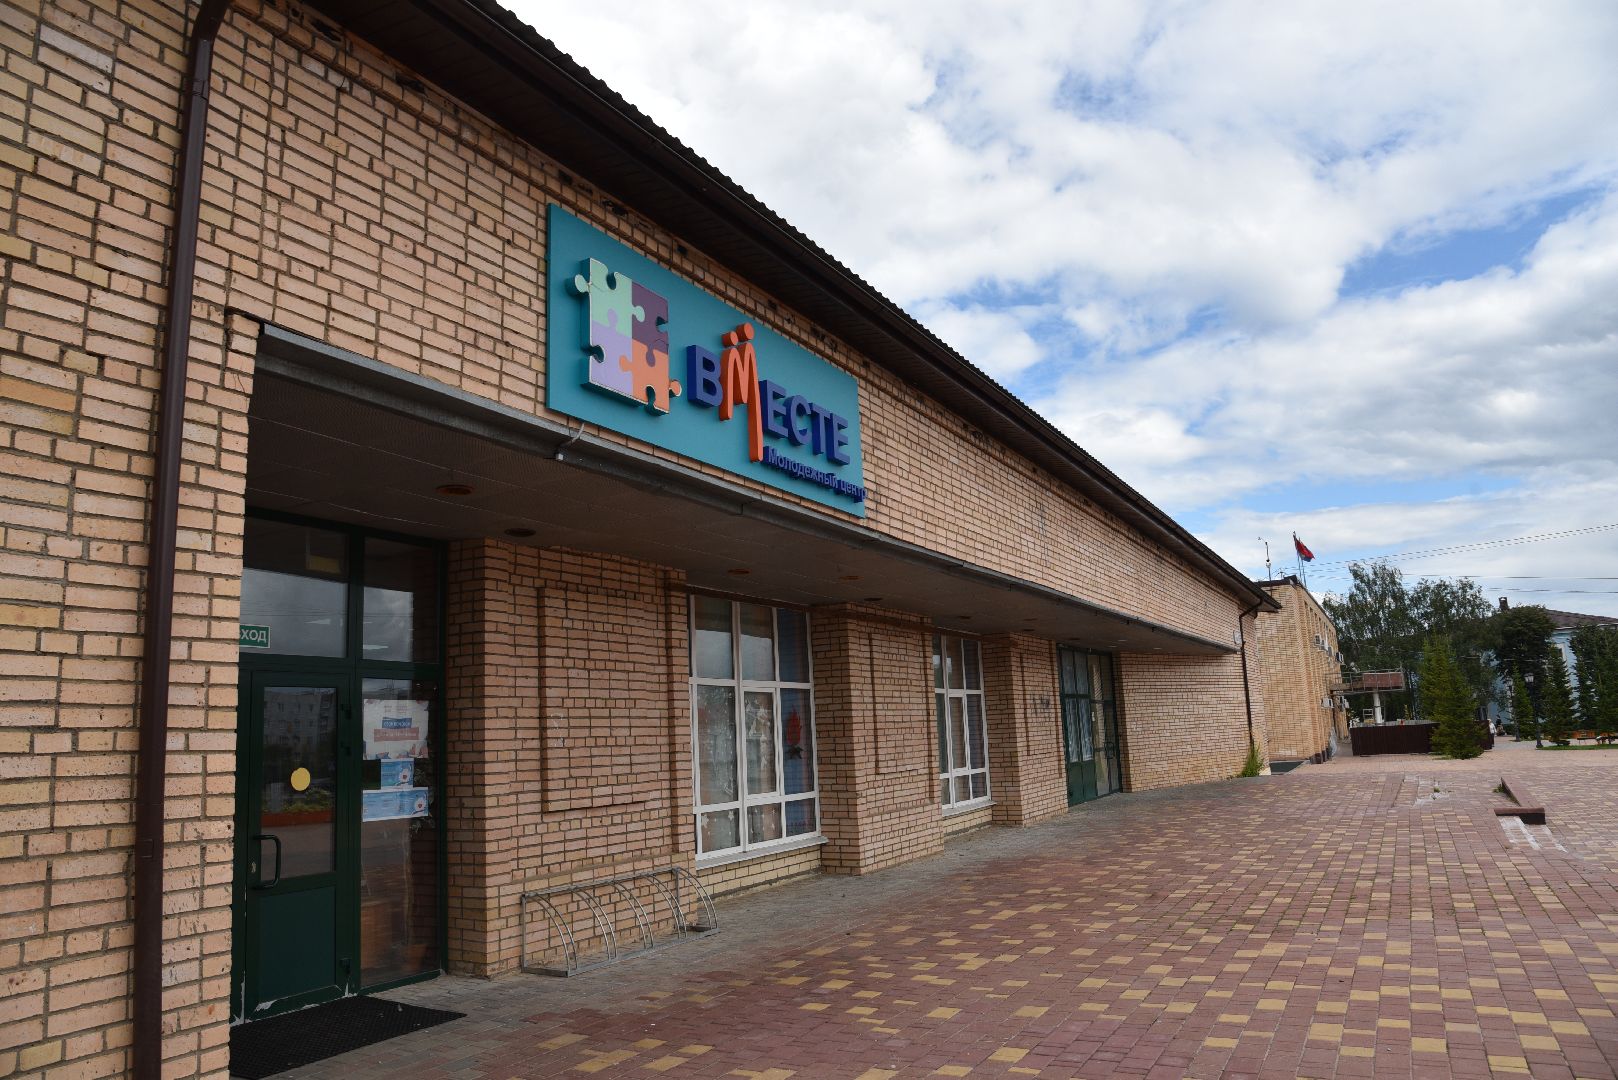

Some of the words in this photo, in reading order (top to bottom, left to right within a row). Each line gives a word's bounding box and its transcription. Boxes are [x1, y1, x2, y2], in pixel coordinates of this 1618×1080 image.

[687, 323, 850, 465] ВМЕСТЕ
[764, 446, 839, 488] Молодежный
[839, 480, 867, 503] центр
[239, 628, 267, 643] ХОД
